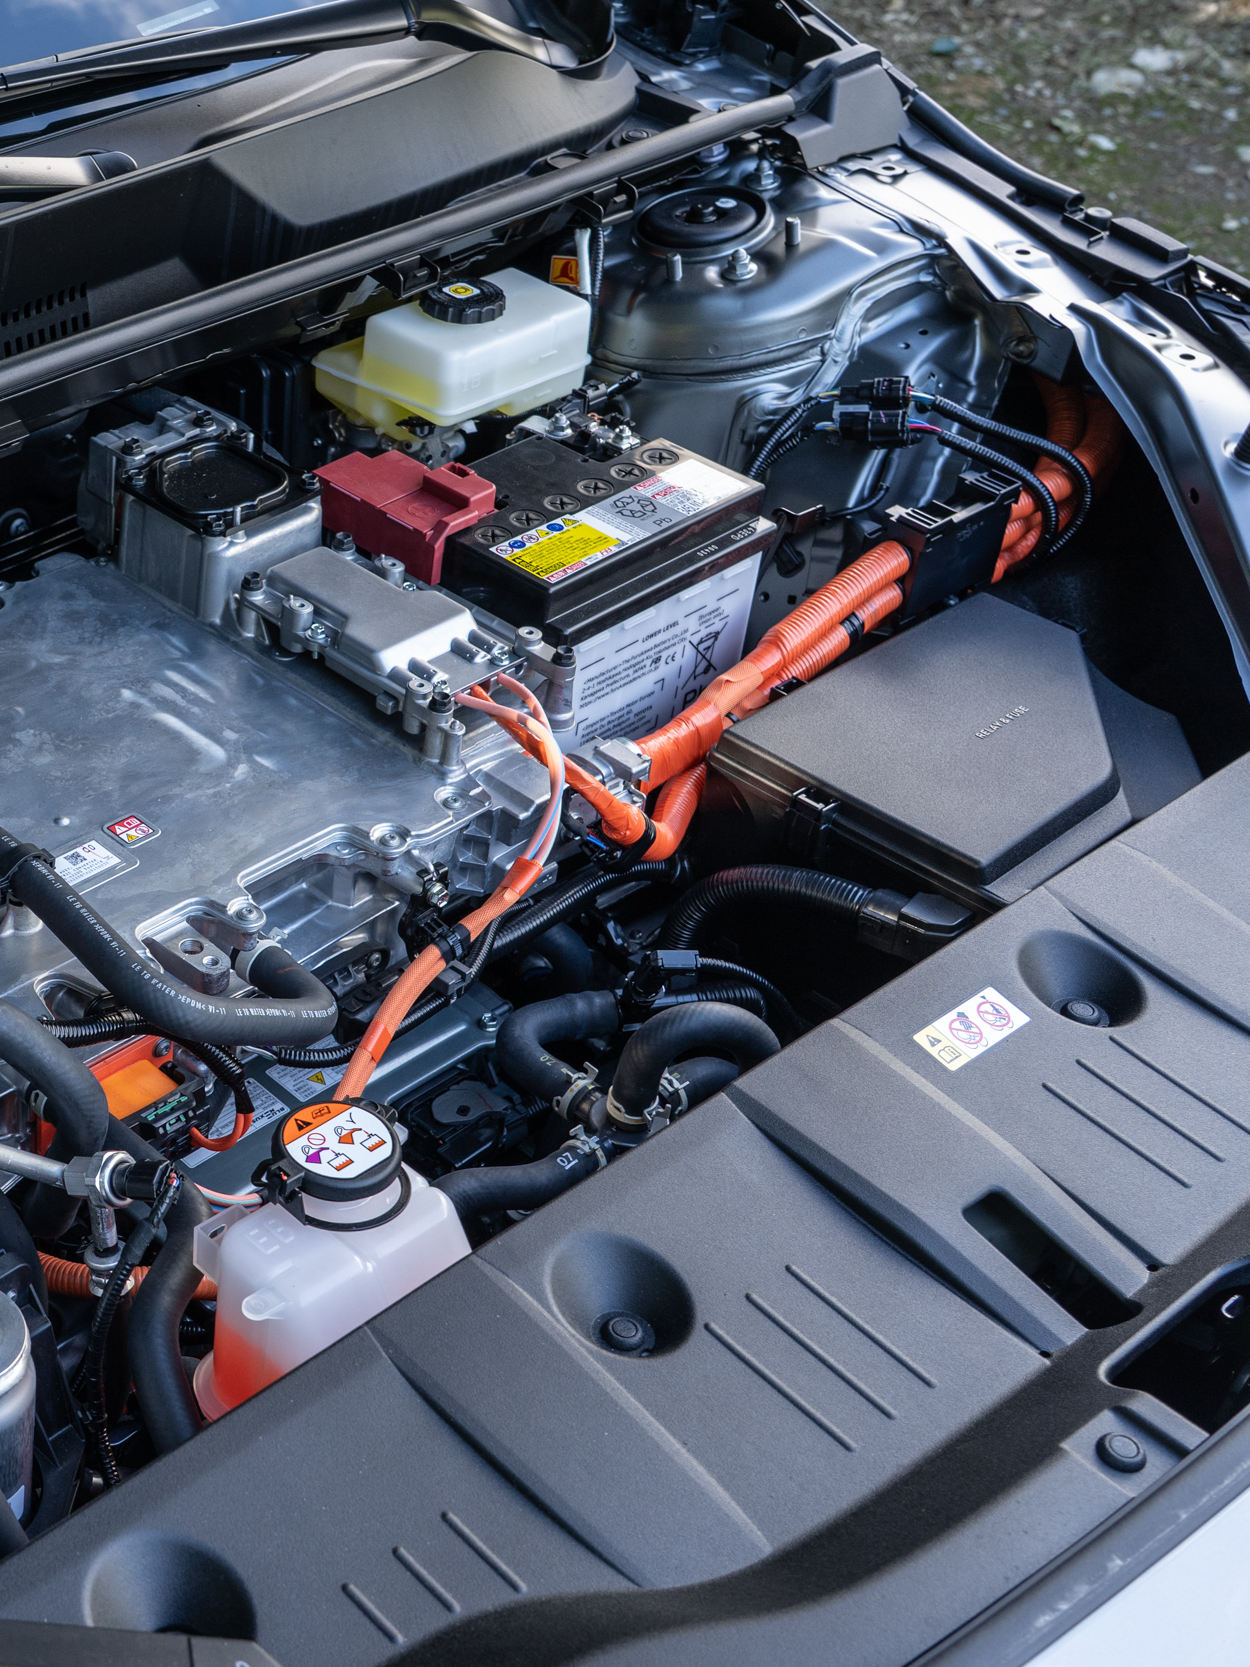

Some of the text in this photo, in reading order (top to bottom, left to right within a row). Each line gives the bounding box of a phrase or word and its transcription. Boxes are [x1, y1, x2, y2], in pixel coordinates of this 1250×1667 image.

[653, 517, 672, 527] Pb
[642, 620, 679, 643] LOWER LEVEL
[653, 638, 671, 650] Battery
[975, 721, 1003, 740] RELAY
[1005, 705, 1029, 721] FUSE
[1, 835, 11, 843] LE
[66, 895, 77, 903] LE
[80, 908, 97, 925] WATER
[93, 922, 113, 943] >EPDM<
[131, 962, 142, 973] LE
[151, 978, 176, 997] WATER
[177, 995, 206, 1011] >EPDM<
[235, 1008, 243, 1017] LE
[249, 1008, 266, 1017] WATER
[301, 1010, 309, 1018] LE
[315, 1009, 328, 1018] WATER
[556, 1151, 574, 1166] 07
